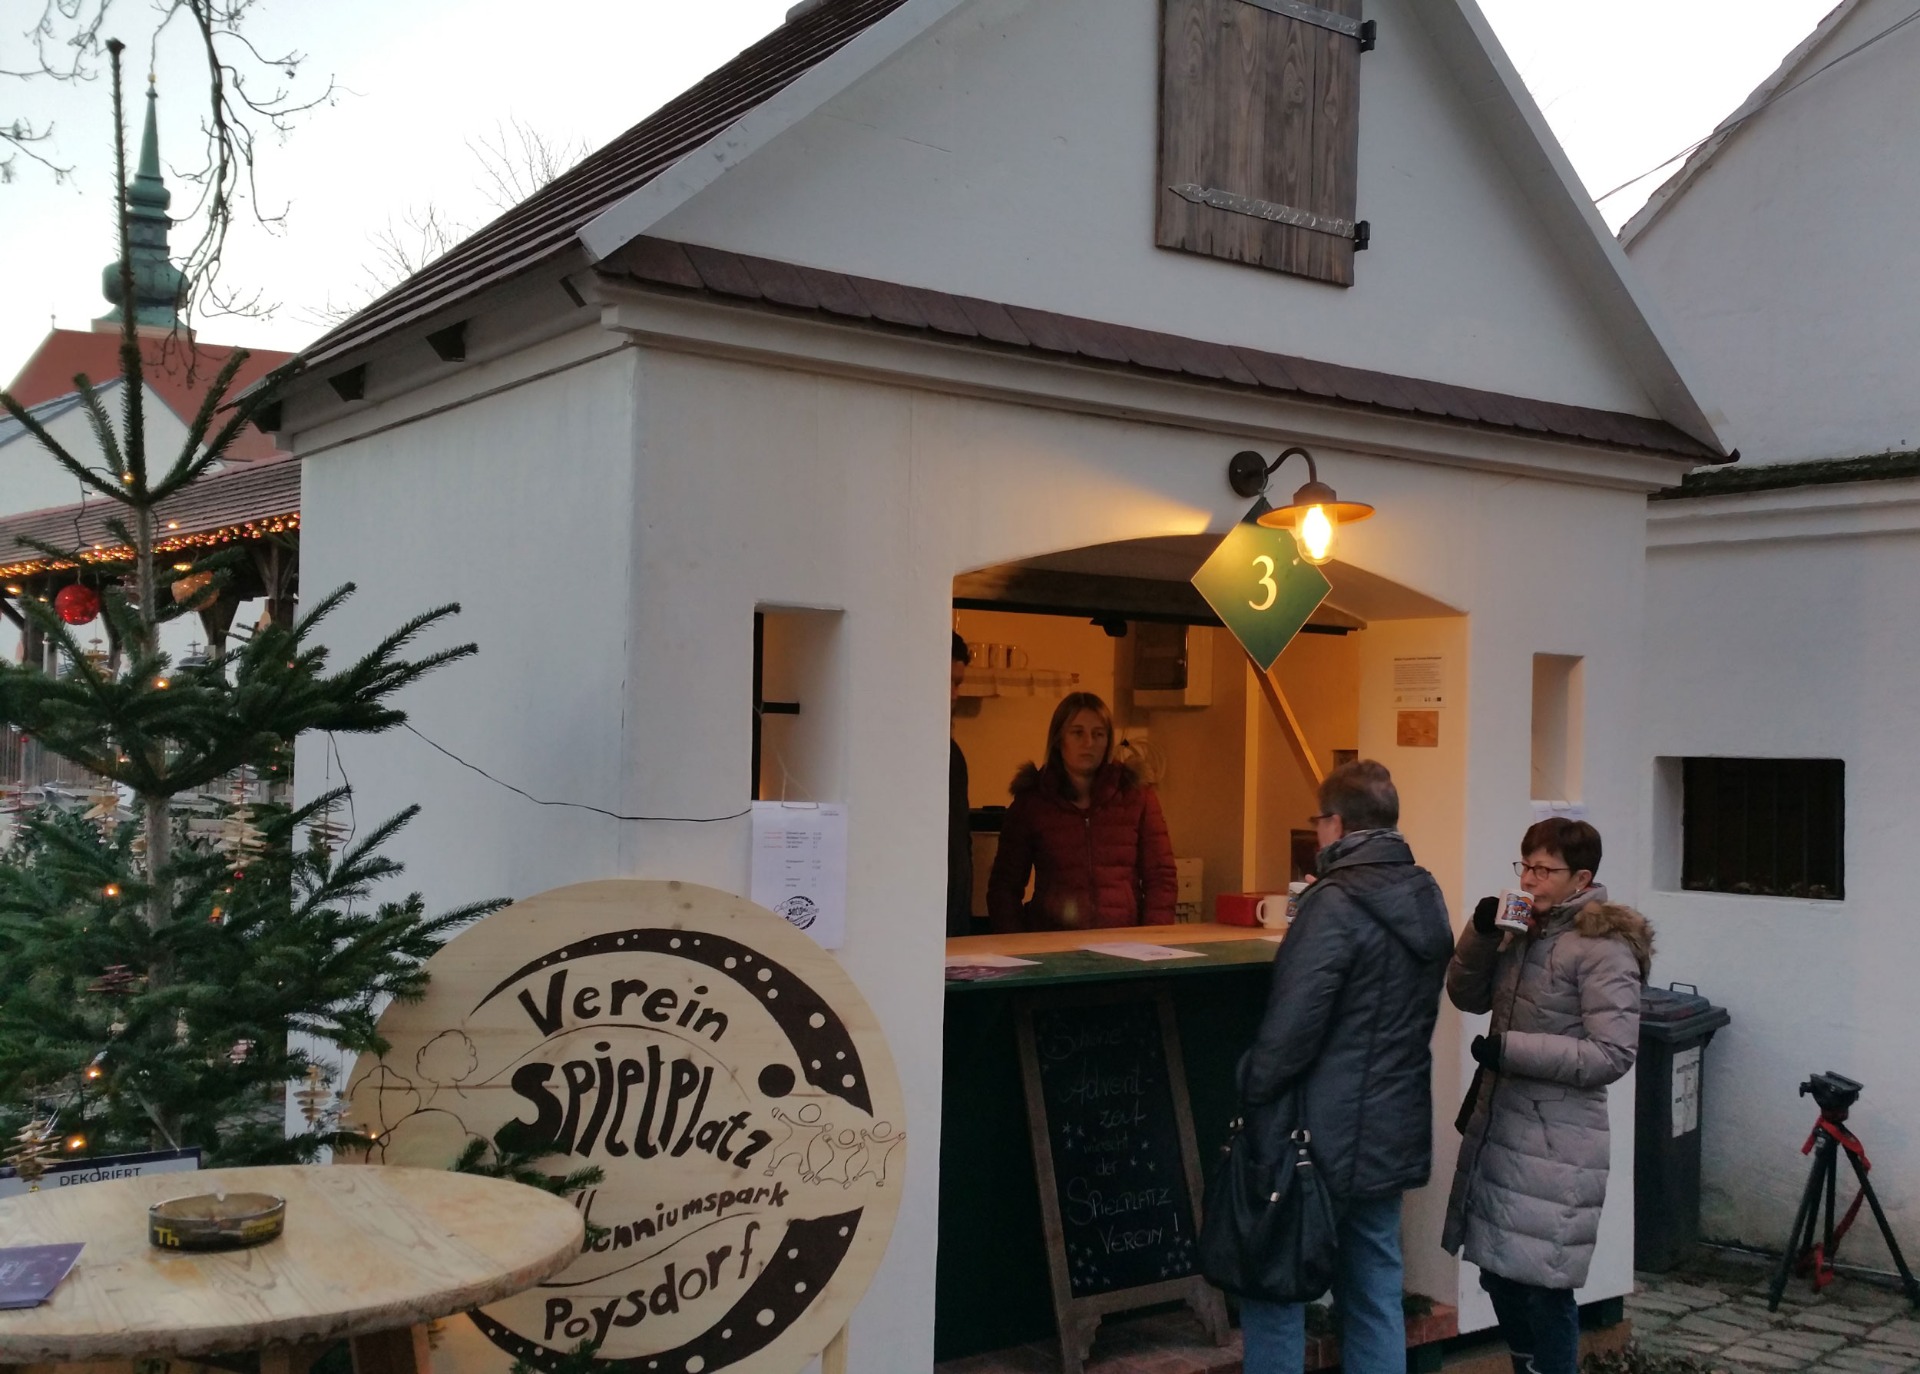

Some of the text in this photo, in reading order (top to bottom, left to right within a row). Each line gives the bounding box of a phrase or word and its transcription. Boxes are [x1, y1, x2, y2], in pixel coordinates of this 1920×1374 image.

[1249, 555, 1277, 611] 3
[517, 968, 729, 1043] Verein
[1095, 1157, 1118, 1176] der
[544, 1221, 760, 1350] Poysdorf
